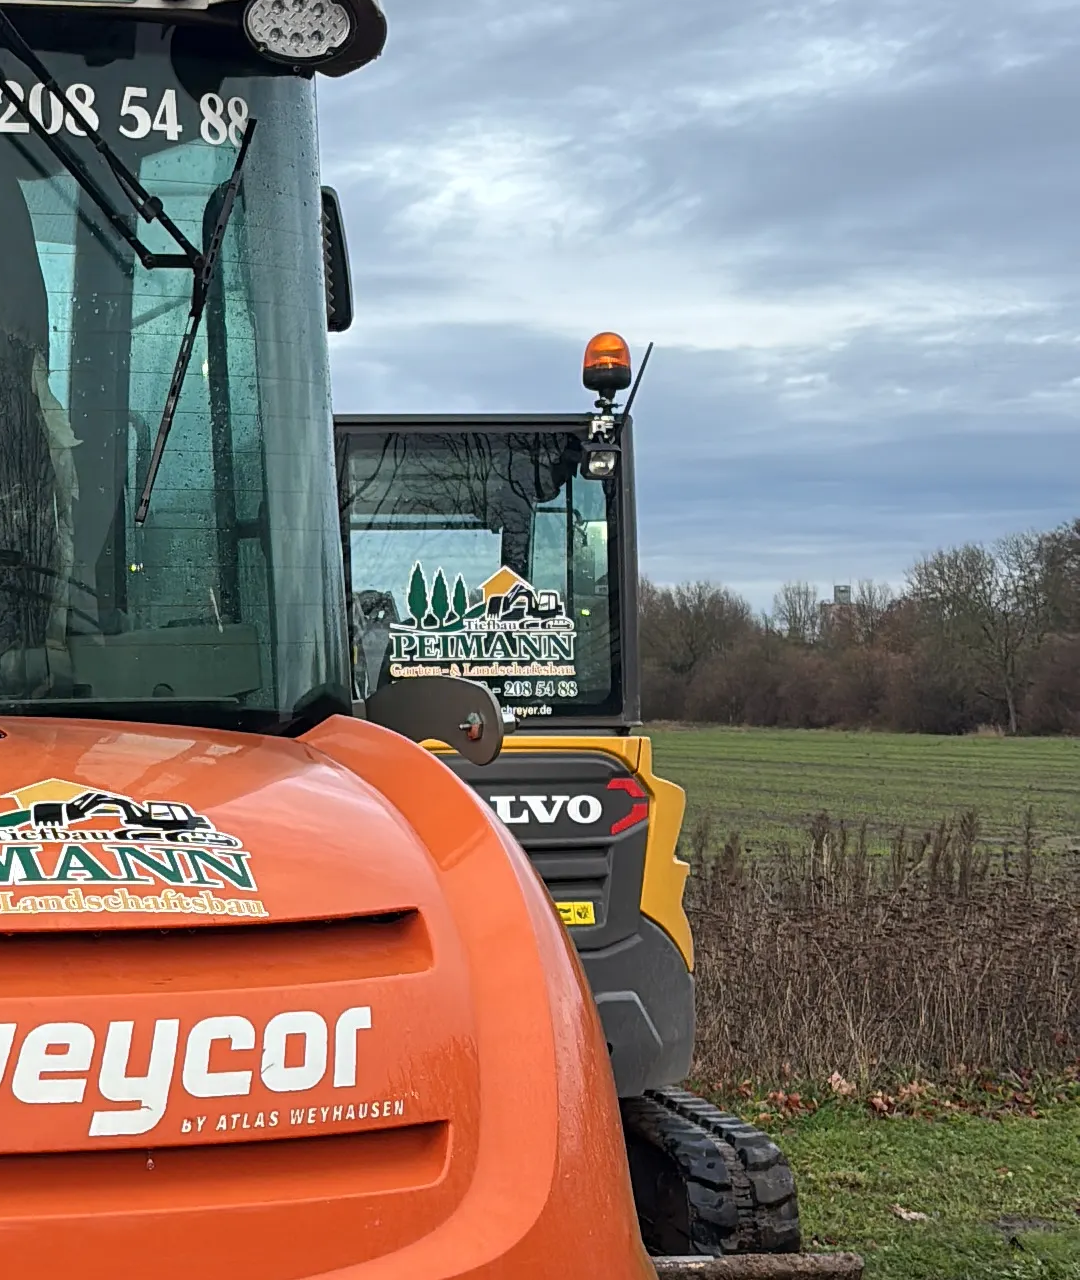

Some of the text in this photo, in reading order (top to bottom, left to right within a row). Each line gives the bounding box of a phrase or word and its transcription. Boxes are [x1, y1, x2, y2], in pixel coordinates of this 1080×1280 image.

[118, 86, 183, 141] 54
[199, 92, 249, 148] 88
[466, 619, 518, 632] Tiefbau
[389, 632, 577, 662] PEIMANN
[390, 662, 576, 677] Garten- & Landschaftsbau
[503, 681, 532, 697] 208
[535, 681, 555, 697] 54
[557, 681, 578, 697] 88
[500, 704, 553, 718] chreyer.de
[490, 795, 602, 824] LVO
[181, 1099, 404, 1133] BY ATLAS WEYHAUSEN
